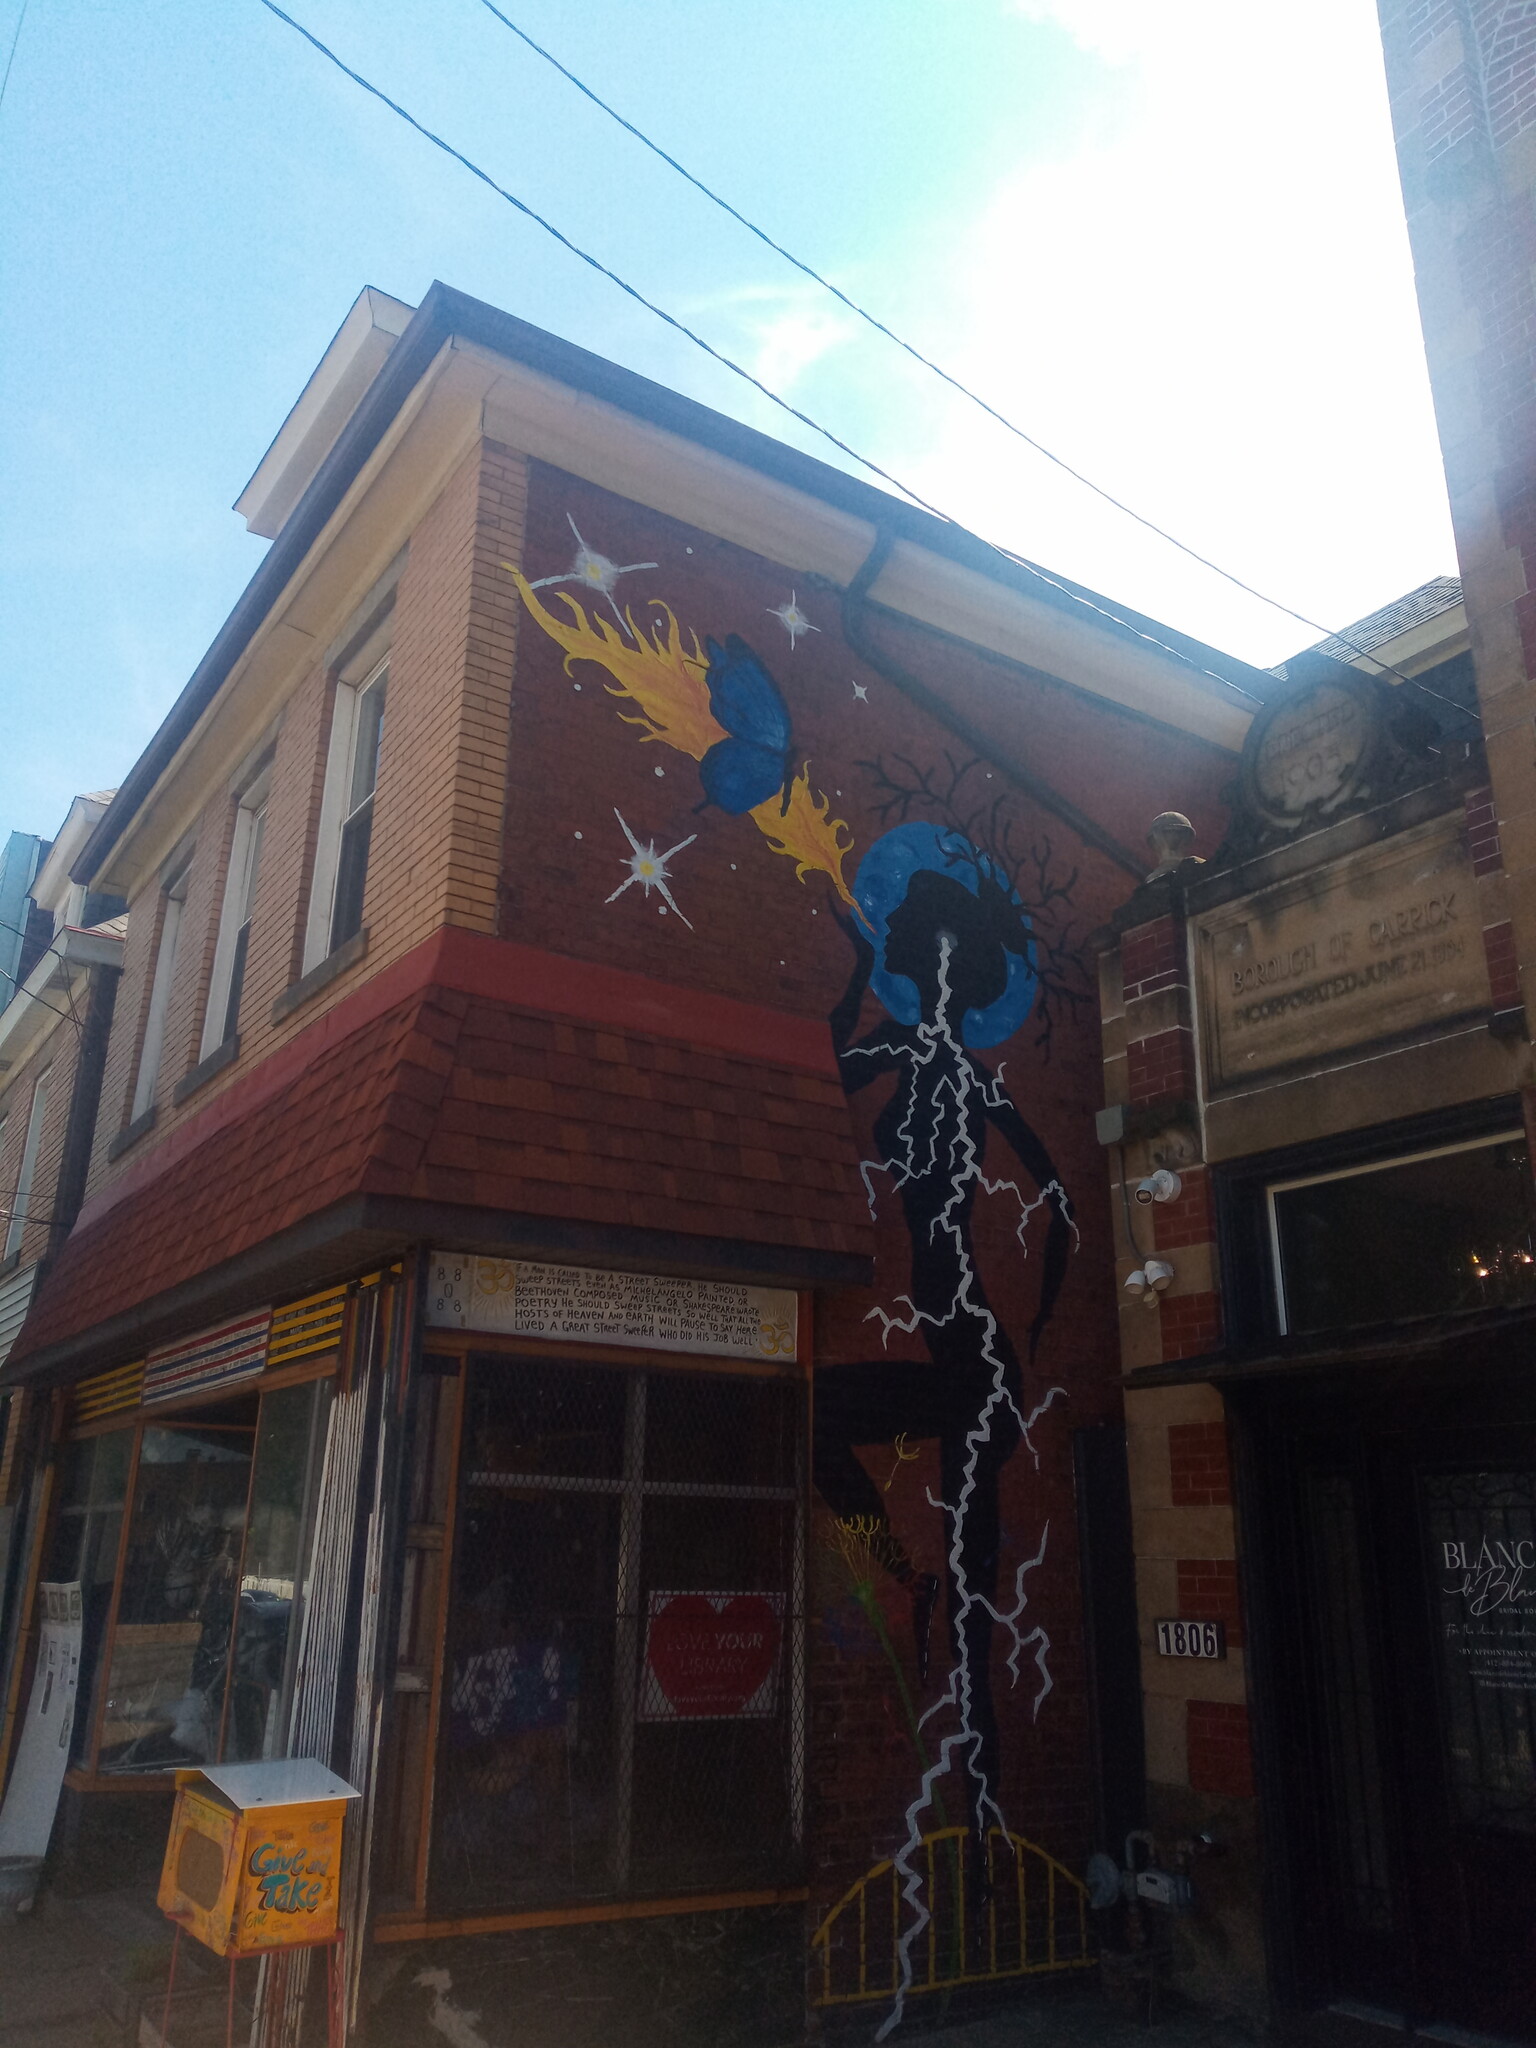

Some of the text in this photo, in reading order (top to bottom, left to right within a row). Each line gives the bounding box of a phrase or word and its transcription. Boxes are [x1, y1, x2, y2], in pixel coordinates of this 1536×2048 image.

[1231, 893, 1458, 996] BOROUGH OF CARRICK
[1232, 972, 1357, 1029] INCORPORATED
[437, 1267, 462, 1282] 8 8
[515, 1286, 569, 1297] BEETHOVEN
[573, 1288, 623, 1301] COMPOSED
[630, 1294, 660, 1304] MUSIC
[667, 1298, 678, 1306] OR
[713, 1283, 748, 1296] SHOULD
[437, 1298, 462, 1313] 8 8
[515, 1298, 557, 1308] POETRY
[578, 1299, 610, 1310] SHOULD
[686, 1311, 695, 1319] SO
[721, 1315, 736, 1323] THAT
[738, 1317, 750, 1325] ALL
[738, 1298, 748, 1306] OR
[515, 1309, 549, 1319] HOSTS
[552, 1310, 564, 1318] OF
[608, 1311, 623, 1320] AND
[659, 1316, 678, 1328] WILL
[681, 1318, 706, 1331] PAUSE
[710, 1323, 719, 1332] TO
[721, 1323, 733, 1332] SAY
[550, 1321, 558, 1331] A
[659, 1328, 677, 1340] WHO
[680, 1330, 693, 1341] DID
[697, 1331, 710, 1342] HIS
[714, 1333, 729, 1344] JOB
[715, 1632, 764, 1650] YOUR
[1161, 1622, 1216, 1657] 1806
[248, 1843, 308, 1877] Give
[257, 1873, 322, 1914] Take
